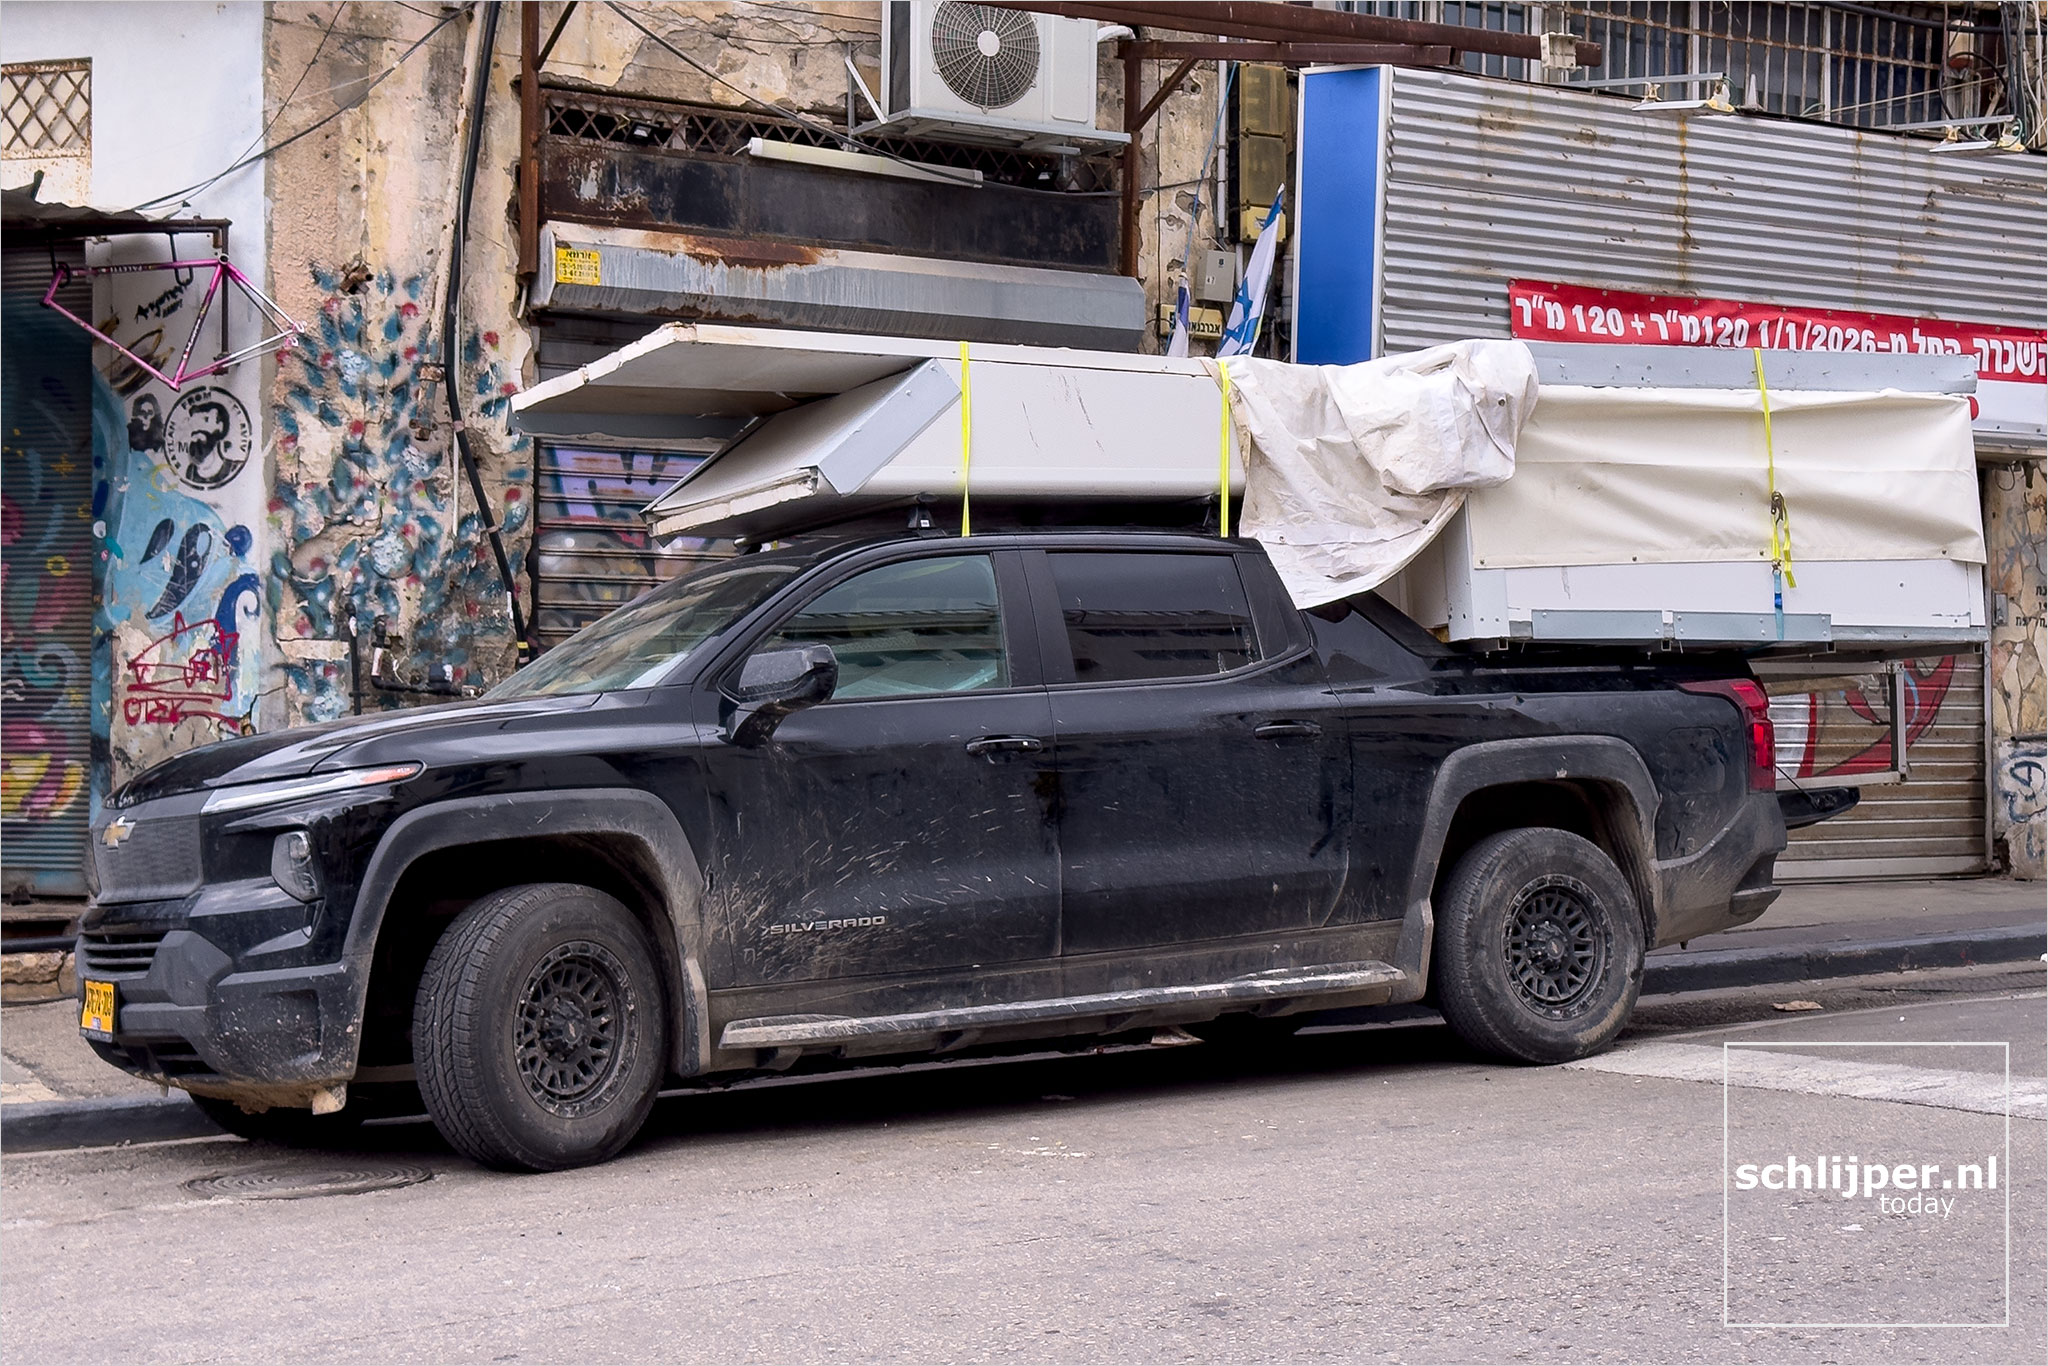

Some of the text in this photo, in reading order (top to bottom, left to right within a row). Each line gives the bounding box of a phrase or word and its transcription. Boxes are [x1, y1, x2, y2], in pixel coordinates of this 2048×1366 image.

[1571, 304, 1625, 337] 120
[1631, 313, 1646, 336] +
[181, 391, 212, 410] FROM
[770, 915, 886, 935] SILVERADO
